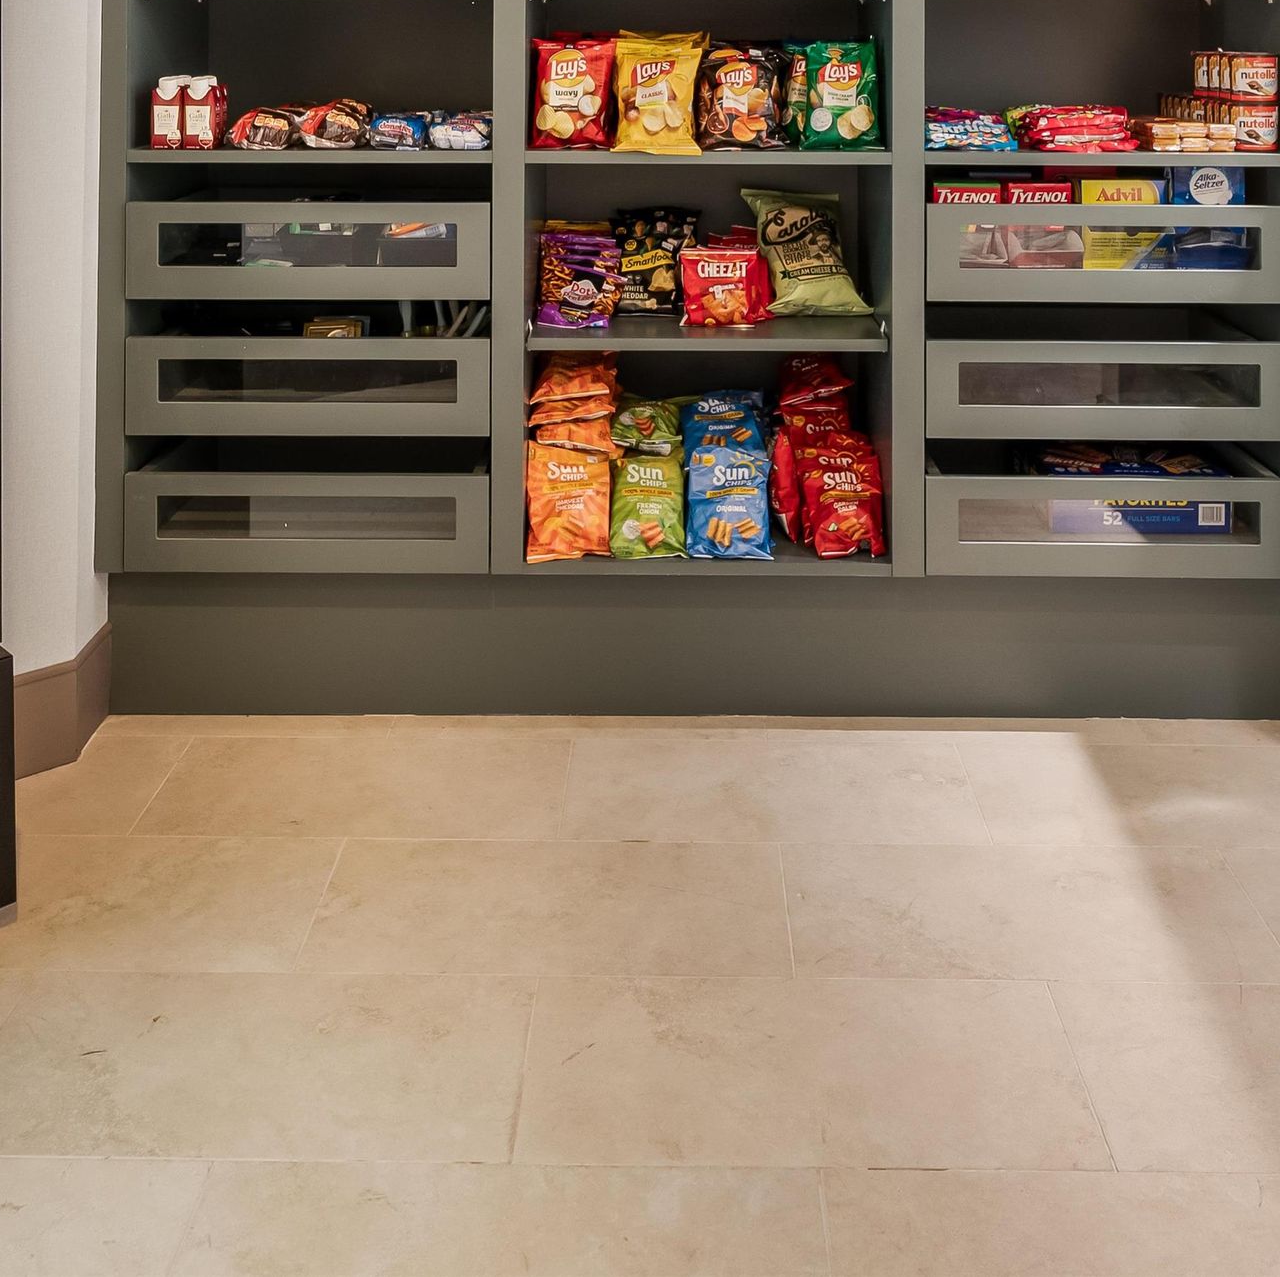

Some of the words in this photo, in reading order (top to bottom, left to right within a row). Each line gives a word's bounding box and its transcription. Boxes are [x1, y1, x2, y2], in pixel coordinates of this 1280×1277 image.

[551, 57, 587, 80] Lay's
[637, 61, 671, 83] Lay's
[824, 63, 858, 81] Lay's
[1240, 68, 1275, 80] nutella
[719, 68, 753, 89] Lay's
[555, 89, 578, 98] wavy
[641, 90, 664, 99] CLASSIC
[1239, 118, 1275, 129] nutella
[1193, 179, 1224, 190] Seltzer
[1196, 173, 1220, 183] Alka-
[937, 189, 997, 203] TYLENOL
[1010, 188, 1068, 203] TYLENOL
[1096, 187, 1142, 202] Advil
[547, 461, 585, 480] Sun
[560, 473, 588, 481] CHIPS
[626, 463, 664, 483] Sun
[713, 464, 750, 486] Sun
[823, 471, 857, 490] Sun
[636, 502, 663, 510] FRENCH
[716, 504, 747, 513] ORIGINAL
[1102, 511, 1123, 526] 52
